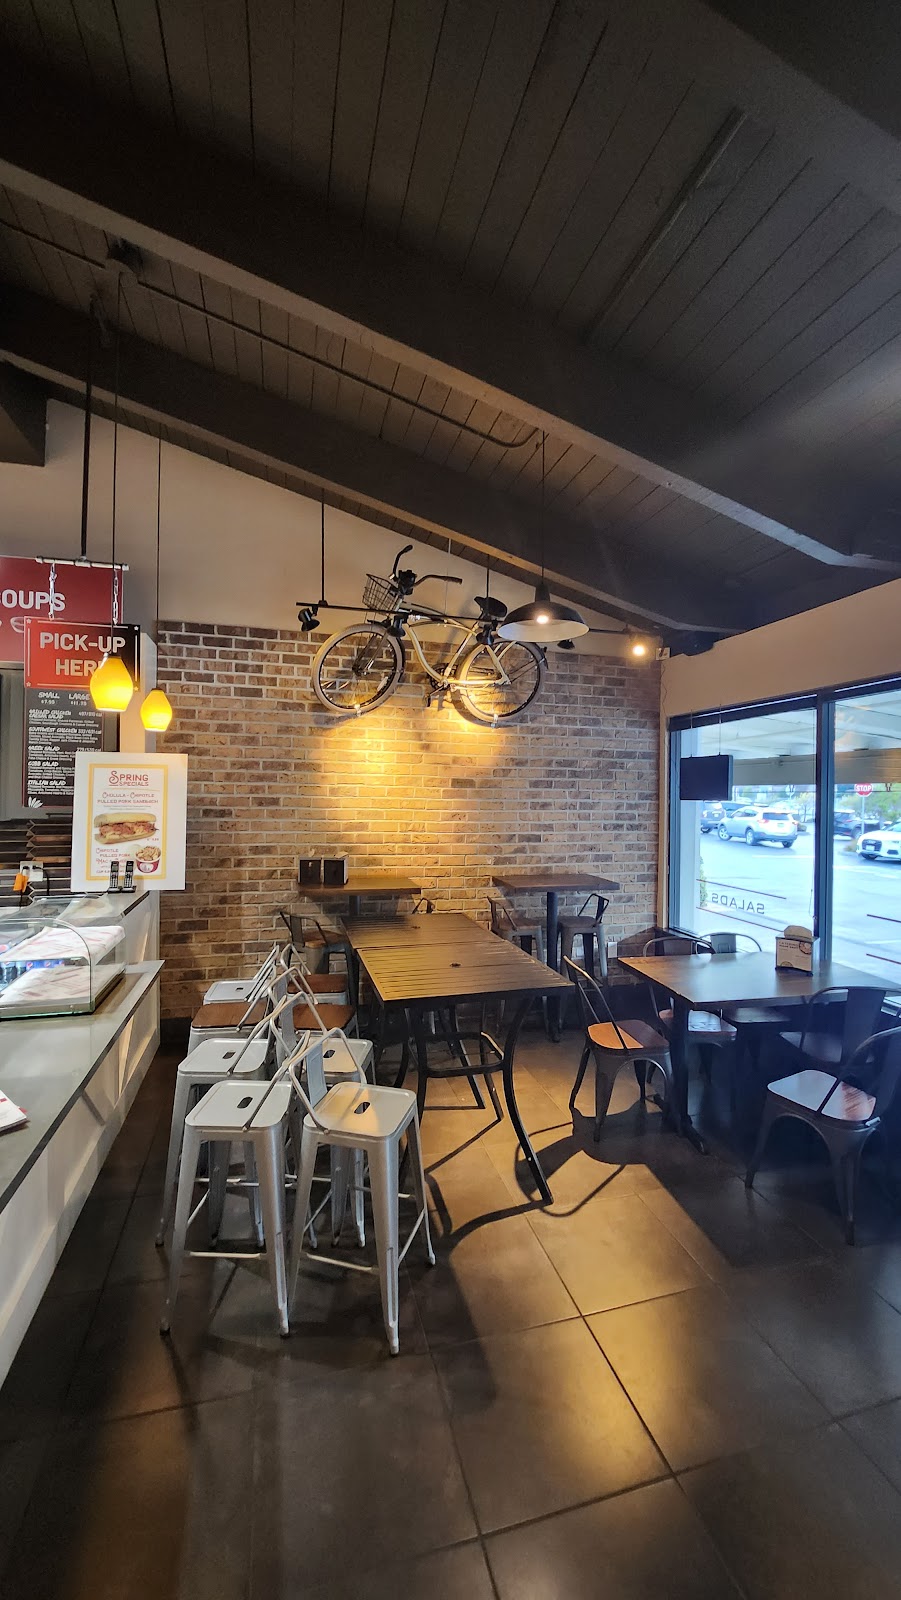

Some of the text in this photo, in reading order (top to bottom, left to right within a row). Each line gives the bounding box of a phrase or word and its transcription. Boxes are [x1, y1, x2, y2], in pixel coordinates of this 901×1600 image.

[0, 589, 66, 612] OUPS
[40, 632, 126, 654] PICK-UP
[55, 658, 102, 677] HER
[38, 691, 90, 701] SMALL LARGE
[109, 770, 149, 785] SPRING
